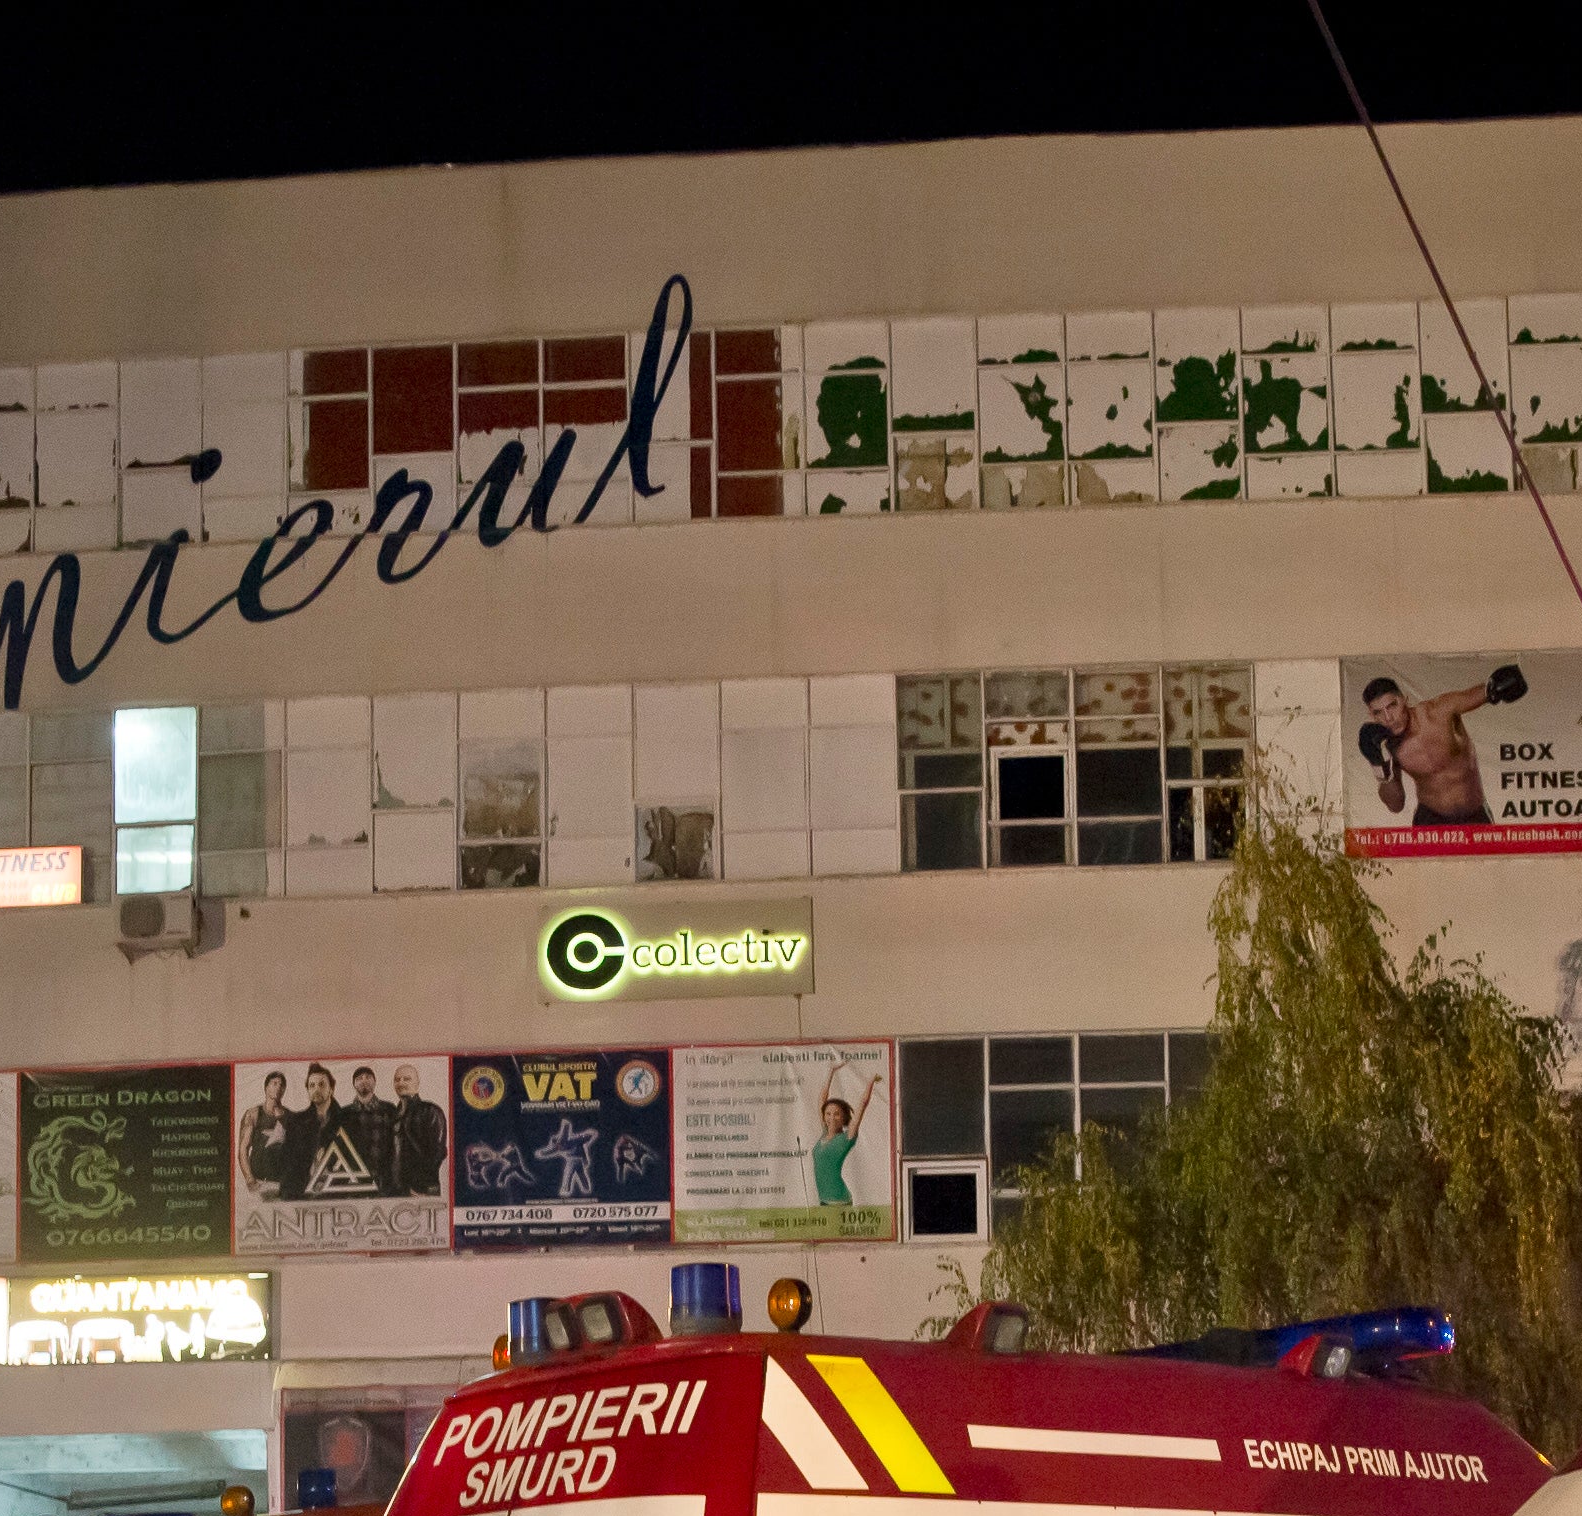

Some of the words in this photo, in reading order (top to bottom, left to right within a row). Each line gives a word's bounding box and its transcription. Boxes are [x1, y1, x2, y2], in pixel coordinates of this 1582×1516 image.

[1500, 743, 1554, 761] BOX
[632, 929, 804, 970] colectiv
[33, 1093, 110, 1108] GREEN
[117, 1089, 212, 1105] DRAGON
[522, 1072, 597, 1102] VAT
[685, 1114, 712, 1128] ESTE
[242, 1201, 448, 1240] ANTRACT
[465, 1210, 500, 1222] 0767
[525, 1208, 553, 1220] 408
[840, 1210, 882, 1225] 100%
[433, 1379, 707, 1466] POMPIERII
[1243, 1438, 1341, 1475] ECHIPAJ
[1347, 1447, 1400, 1478] PRIM
[1403, 1452, 1489, 1484] AJUTOR
[459, 1445, 617, 1508] SMURD
